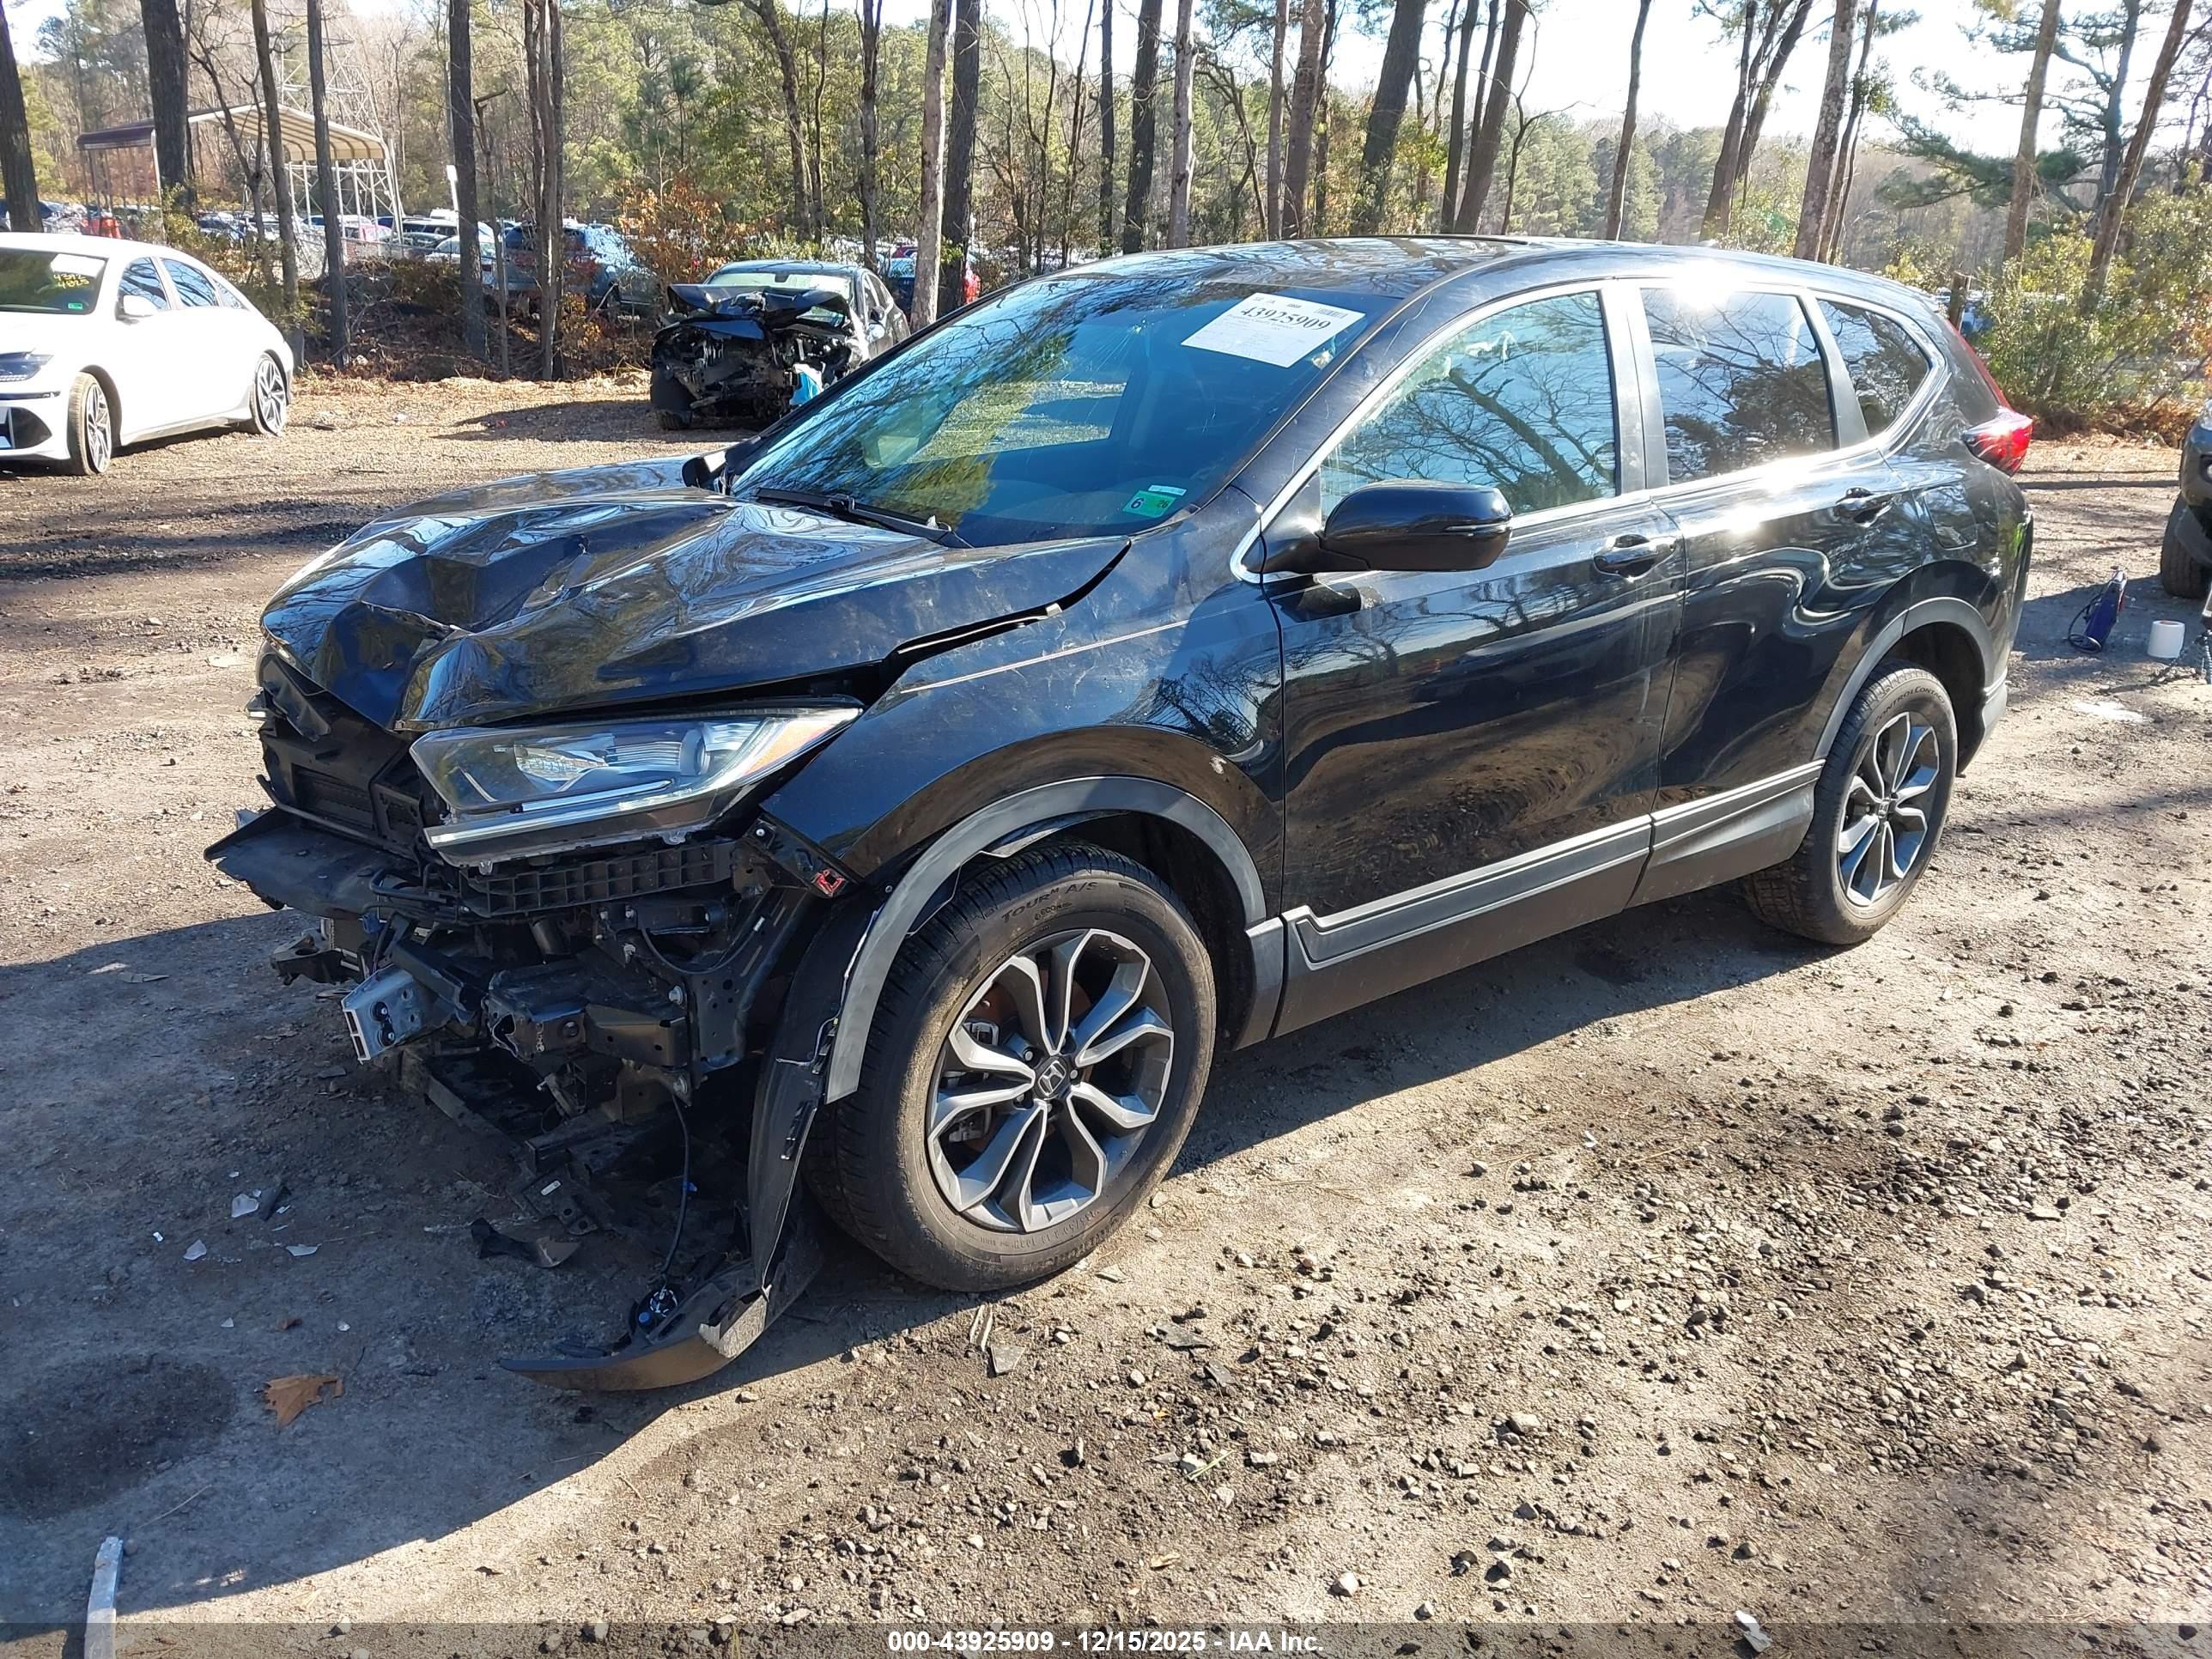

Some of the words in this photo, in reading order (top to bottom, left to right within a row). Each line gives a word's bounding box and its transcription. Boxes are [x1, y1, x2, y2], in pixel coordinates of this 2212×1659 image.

[1241, 306, 1331, 331] 43925909
[1130, 497, 1145, 509] 6
[1065, 881, 1098, 895] A/S
